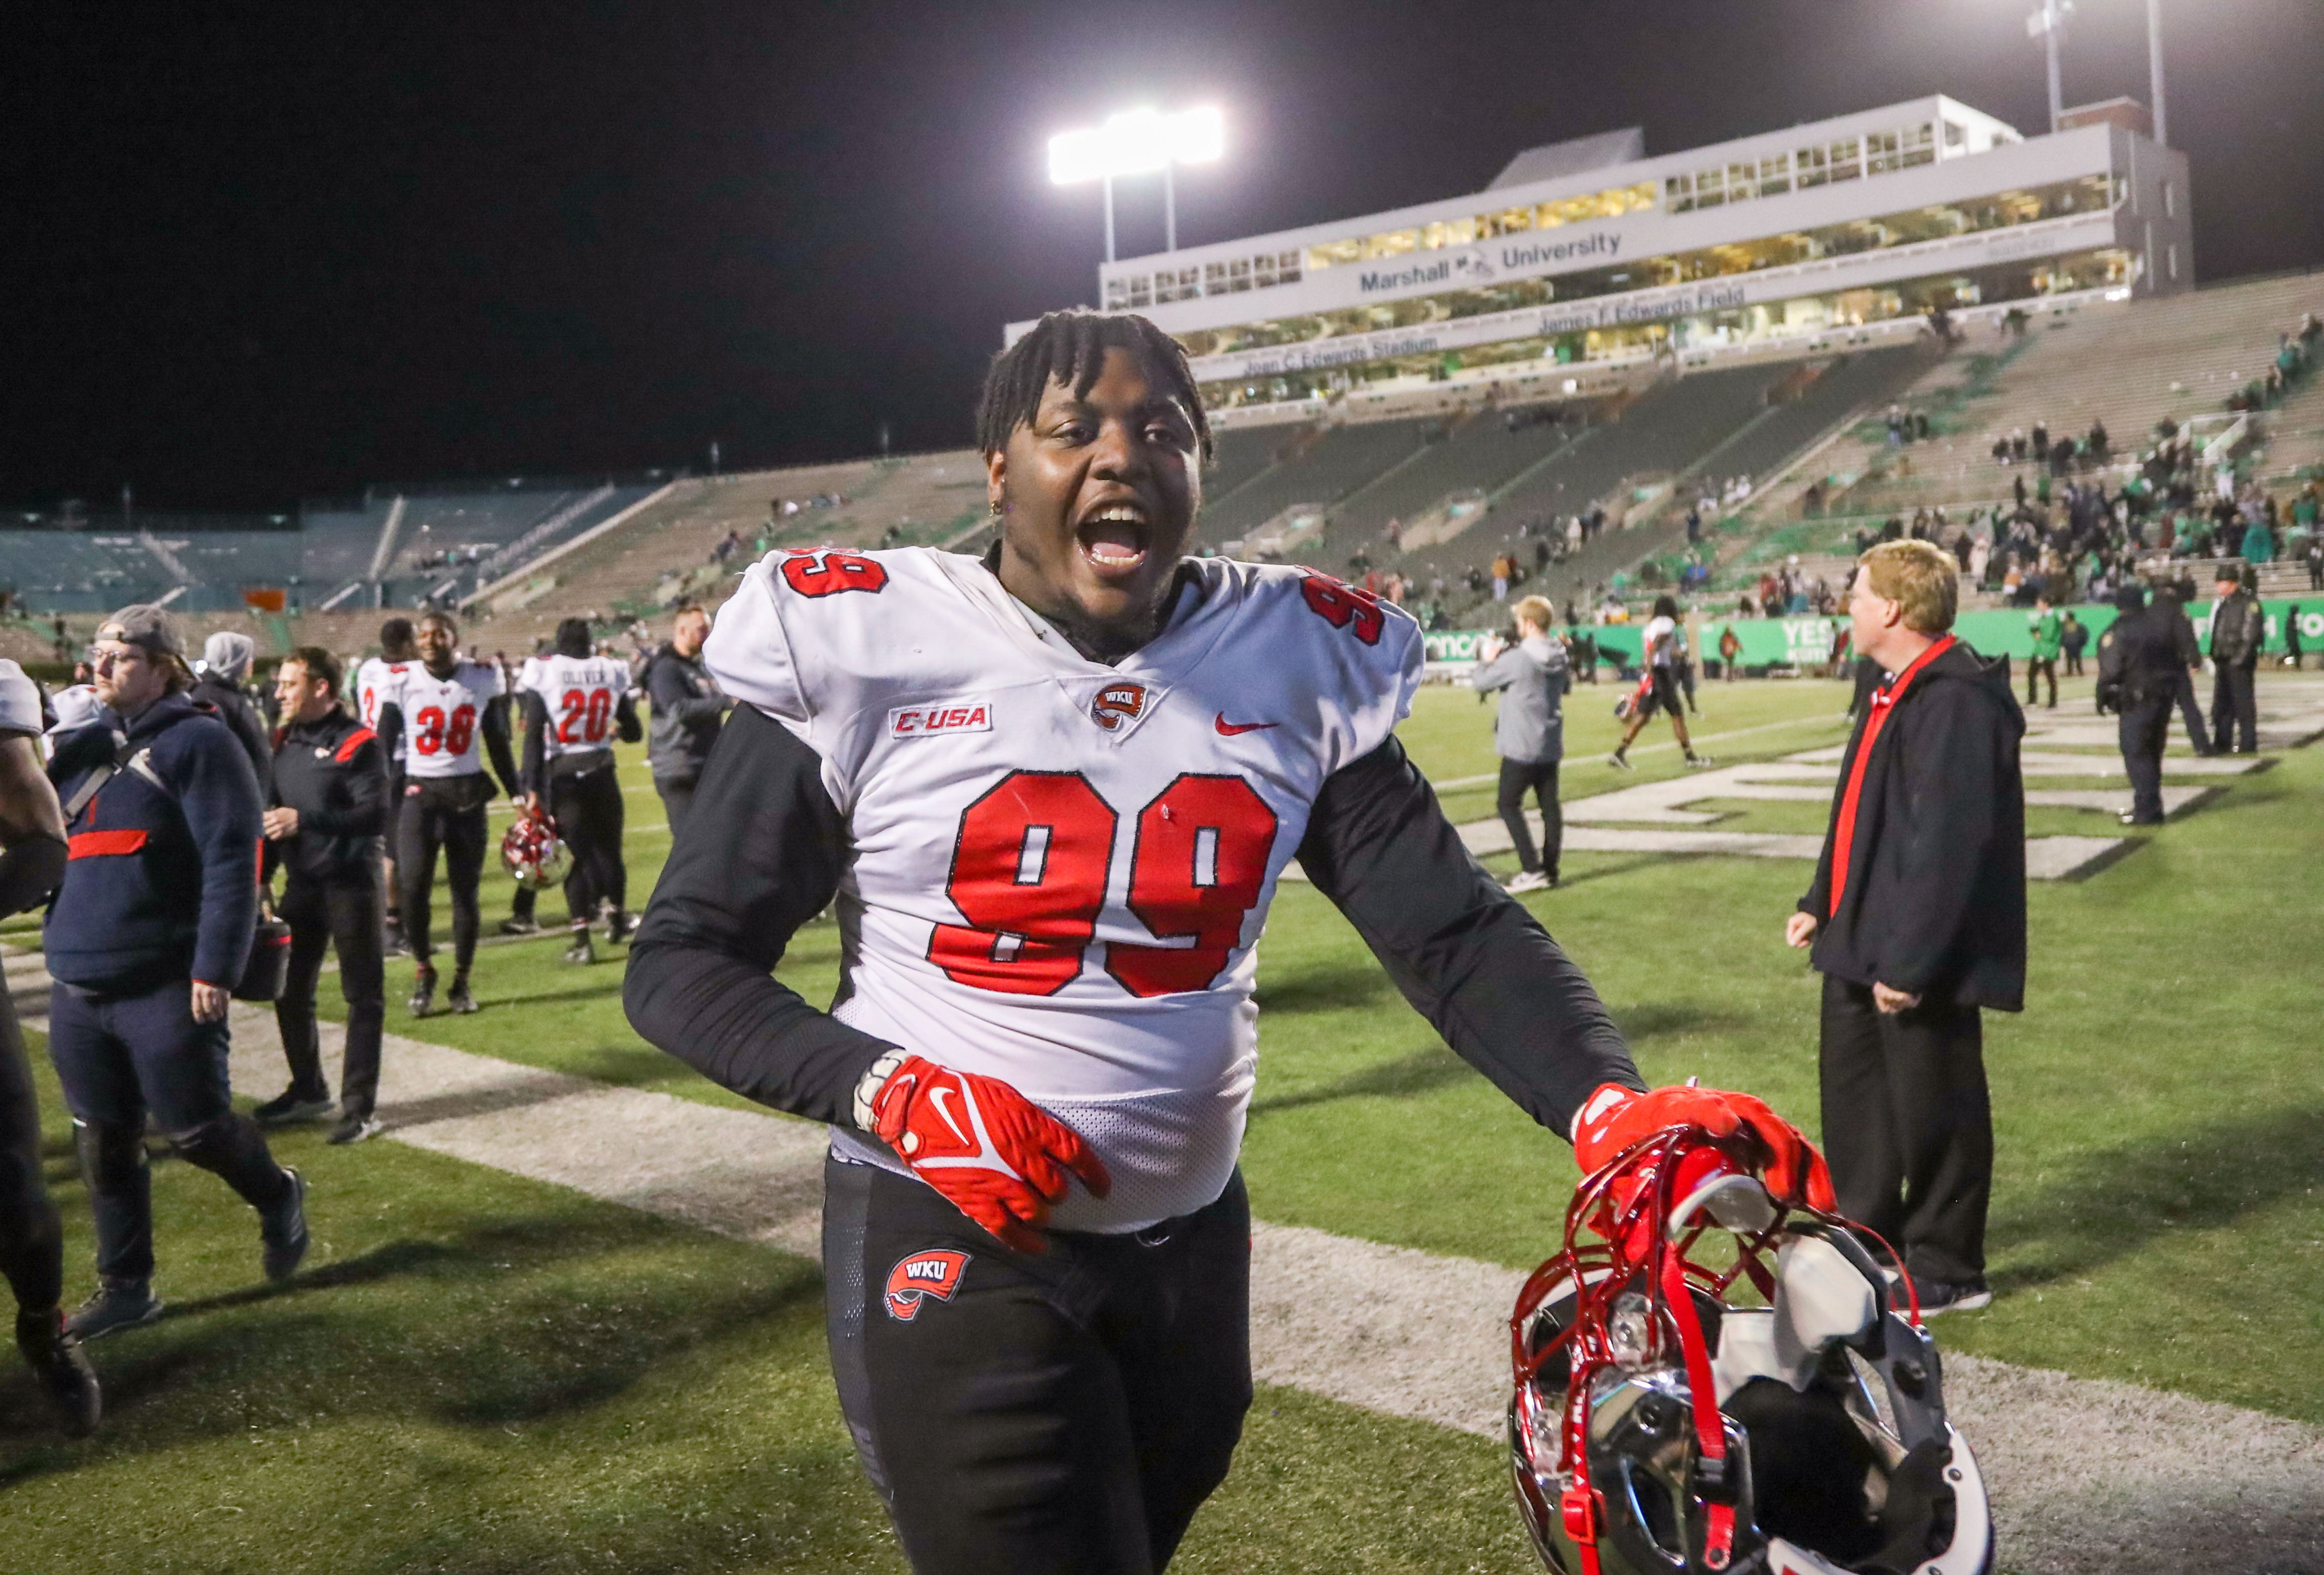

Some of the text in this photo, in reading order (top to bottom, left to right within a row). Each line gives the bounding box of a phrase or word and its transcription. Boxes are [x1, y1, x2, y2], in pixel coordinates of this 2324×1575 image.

[1361, 232, 1622, 292] Marshall University
[1539, 314, 1594, 334] James
[1616, 297, 1692, 322] Edwards
[1698, 287, 1744, 310] Field
[1302, 347, 1367, 367] Edwards
[1373, 337, 1438, 356] Stadium
[557, 688, 611, 744] 20
[1105, 691, 1133, 705] WKU
[416, 704, 475, 756] 38
[926, 768, 1278, 998] 99
[905, 1260, 948, 1280] WKU
